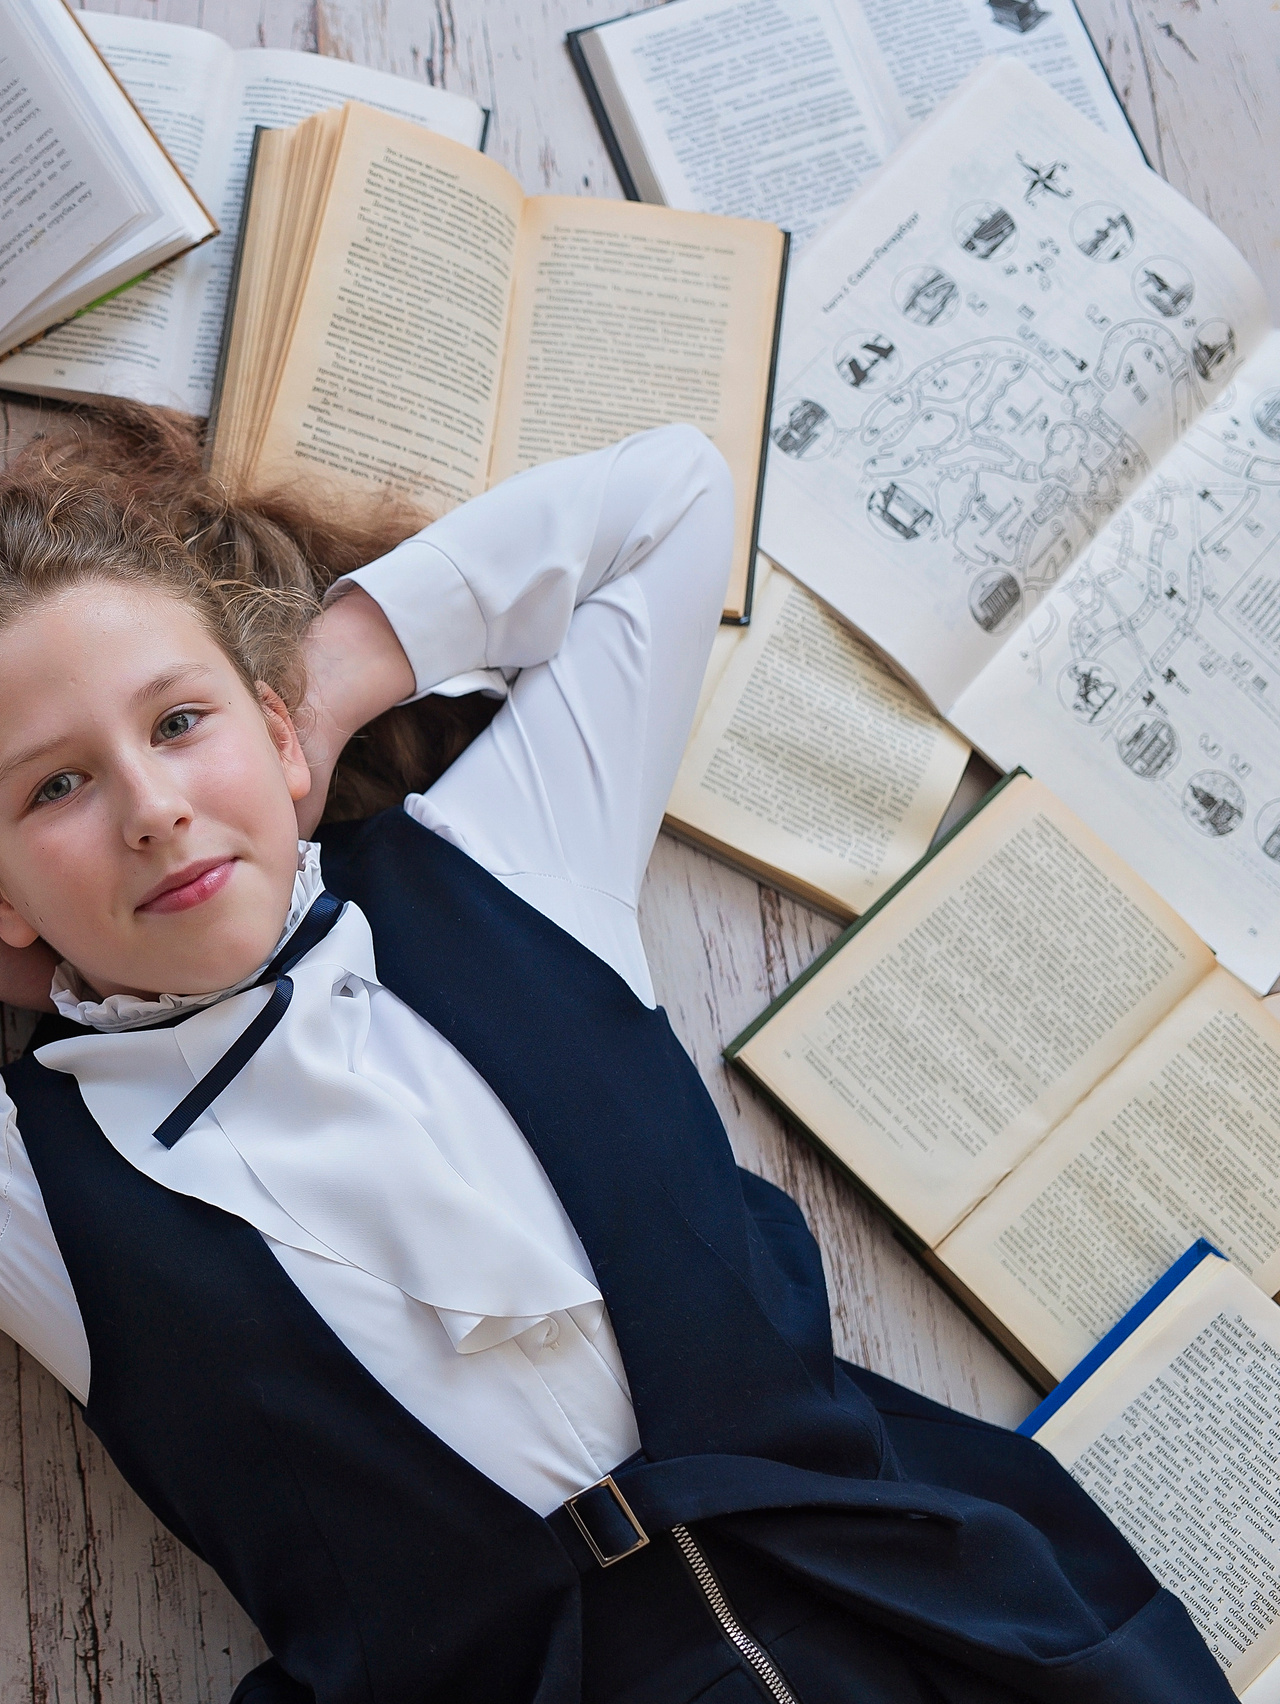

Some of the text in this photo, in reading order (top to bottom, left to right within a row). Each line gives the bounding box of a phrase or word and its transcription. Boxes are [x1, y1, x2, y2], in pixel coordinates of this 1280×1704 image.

[1234, 1314, 1257, 1339] Элиза
[1073, 1461, 1091, 1477] шей
[1094, 1481, 1110, 1496] еще
[1114, 1500, 1147, 1531] крепким
[1150, 1533, 1171, 1554] сном
[1174, 1556, 1214, 1594] сестрицей
[1228, 1607, 1260, 1640] облакам.
[1080, 1454, 1113, 1486] схватили
[1113, 1486, 1135, 1507] сетку
[1134, 1506, 1169, 1539] клювами
[1177, 1546, 1212, 1579] взвились
[1219, 1585, 1246, 1613] милой,
[1247, 1612, 1267, 1631] спав-
[1087, 1448, 1117, 1477] тившись
[1137, 1495, 1167, 1523] восходе
[1171, 1526, 1198, 1553] солнца
[1212, 1566, 1245, 1598] лебедей,
[1249, 1599, 1274, 1625] братья
[1089, 1489, 1114, 1514] солнца
[1117, 1516, 1147, 1545] светили
[1162, 1559, 1187, 1583] прямо
[1198, 1593, 1219, 1616] лицо,
[1223, 1615, 1254, 1647] поэтому
[1093, 1440, 1110, 1456] шая
[1122, 1467, 1156, 1500] прочная;
[1167, 1509, 1182, 1524] нее
[1184, 1525, 1223, 1562] положили
[1225, 1561, 1251, 1589] Элизу;
[1252, 1589, 1280, 1617] превра-
[1152, 1563, 1168, 1579] над
[1180, 1589, 1212, 1622] головой,
[1212, 1620, 1247, 1654] защищая
[1210, 1644, 1233, 1669] Элиза
